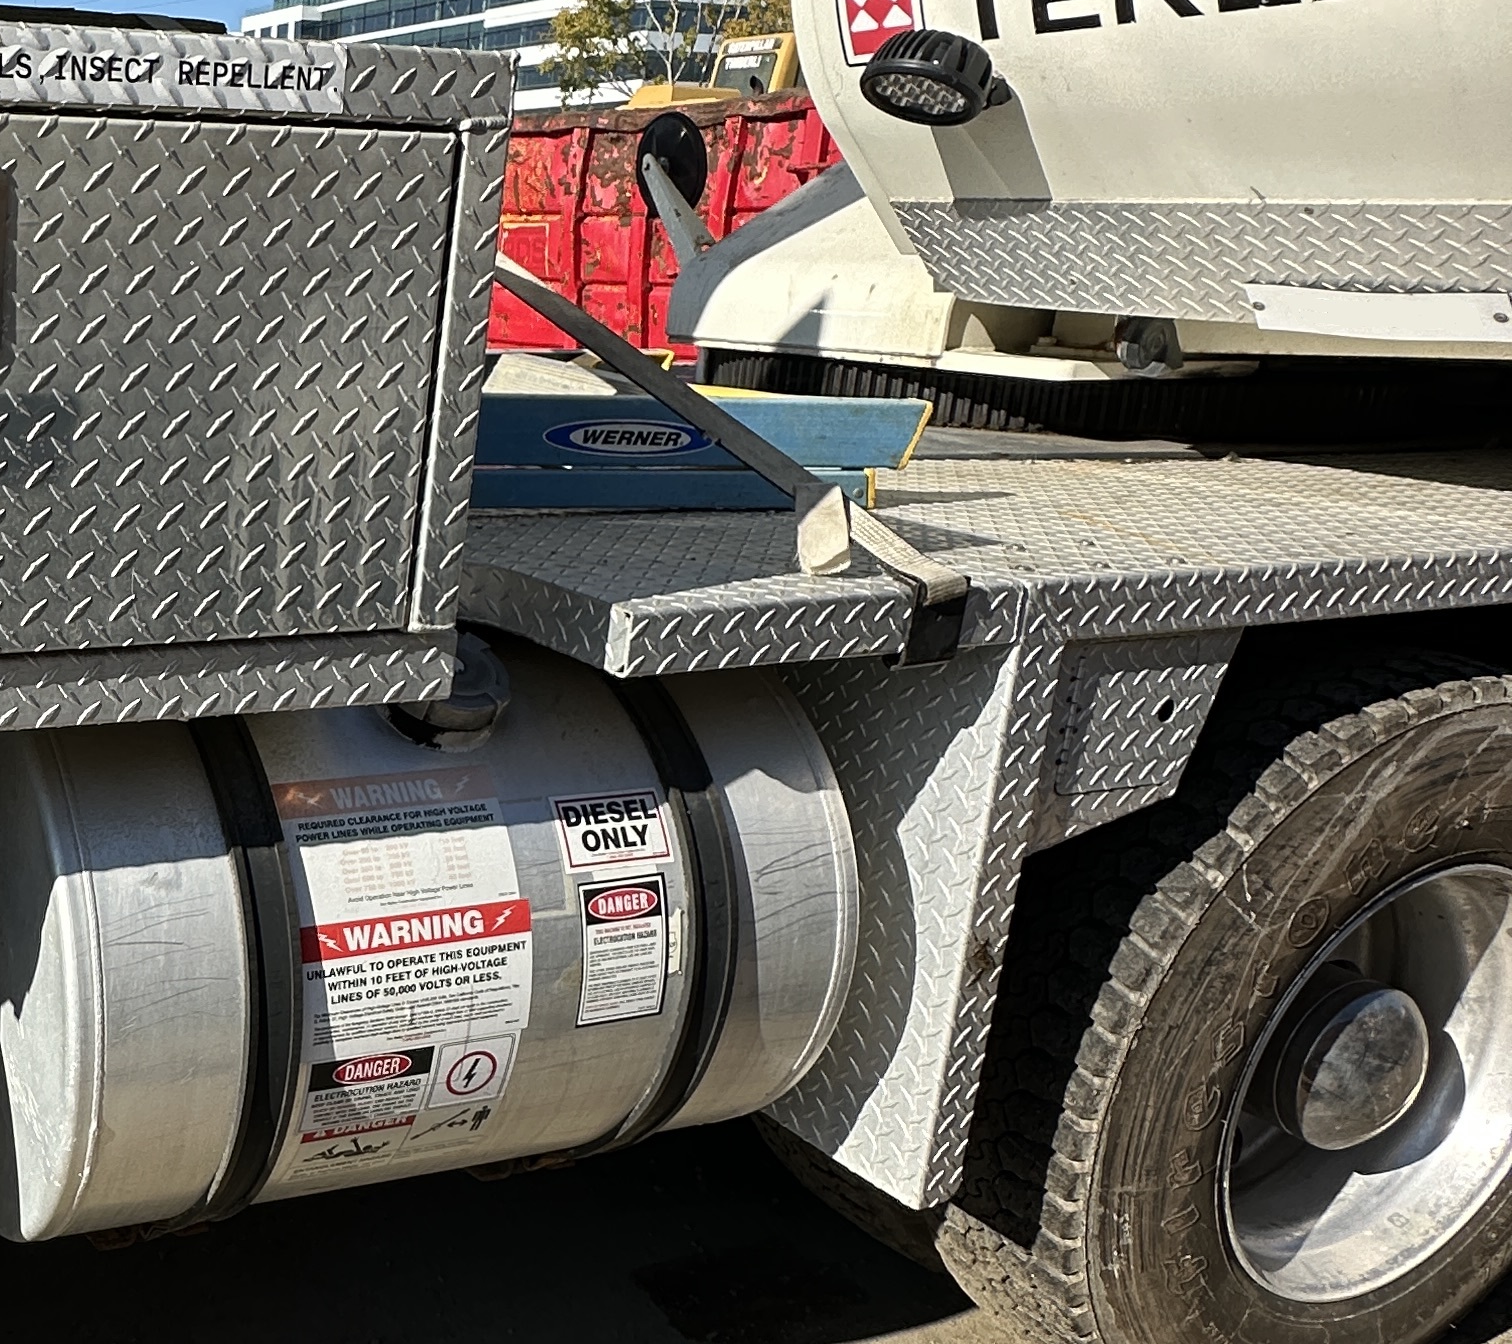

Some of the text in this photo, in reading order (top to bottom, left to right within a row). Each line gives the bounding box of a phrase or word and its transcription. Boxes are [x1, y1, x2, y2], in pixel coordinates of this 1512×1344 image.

[53, 57, 160, 85] INSECT
[581, 429, 681, 447] WERNER
[331, 778, 443, 809] WARNING
[298, 803, 488, 831] REQUIRED CLEARANCE FOR HIGH VOLTAGE
[561, 798, 658, 828] DIESEL
[295, 813, 495, 843] POWER LINES WHILE OPERATING EQUIPMENT
[581, 824, 649, 852] ONLY
[597, 892, 649, 915] DANGER
[343, 909, 484, 952] WARNING
[306, 940, 527, 981] UNLAWFUL TO OPERATE THIS EQUIPMENT
[328, 956, 508, 992] WITHIN 10 FEET OF HIGH-VOLTAGE
[330, 971, 502, 1005] LINES OF 50,000 VOLTS OR LESS.
[344, 1058, 401, 1081] DANGER
[314, 1078, 422, 1102] ELECTROCUTION HAZARD
